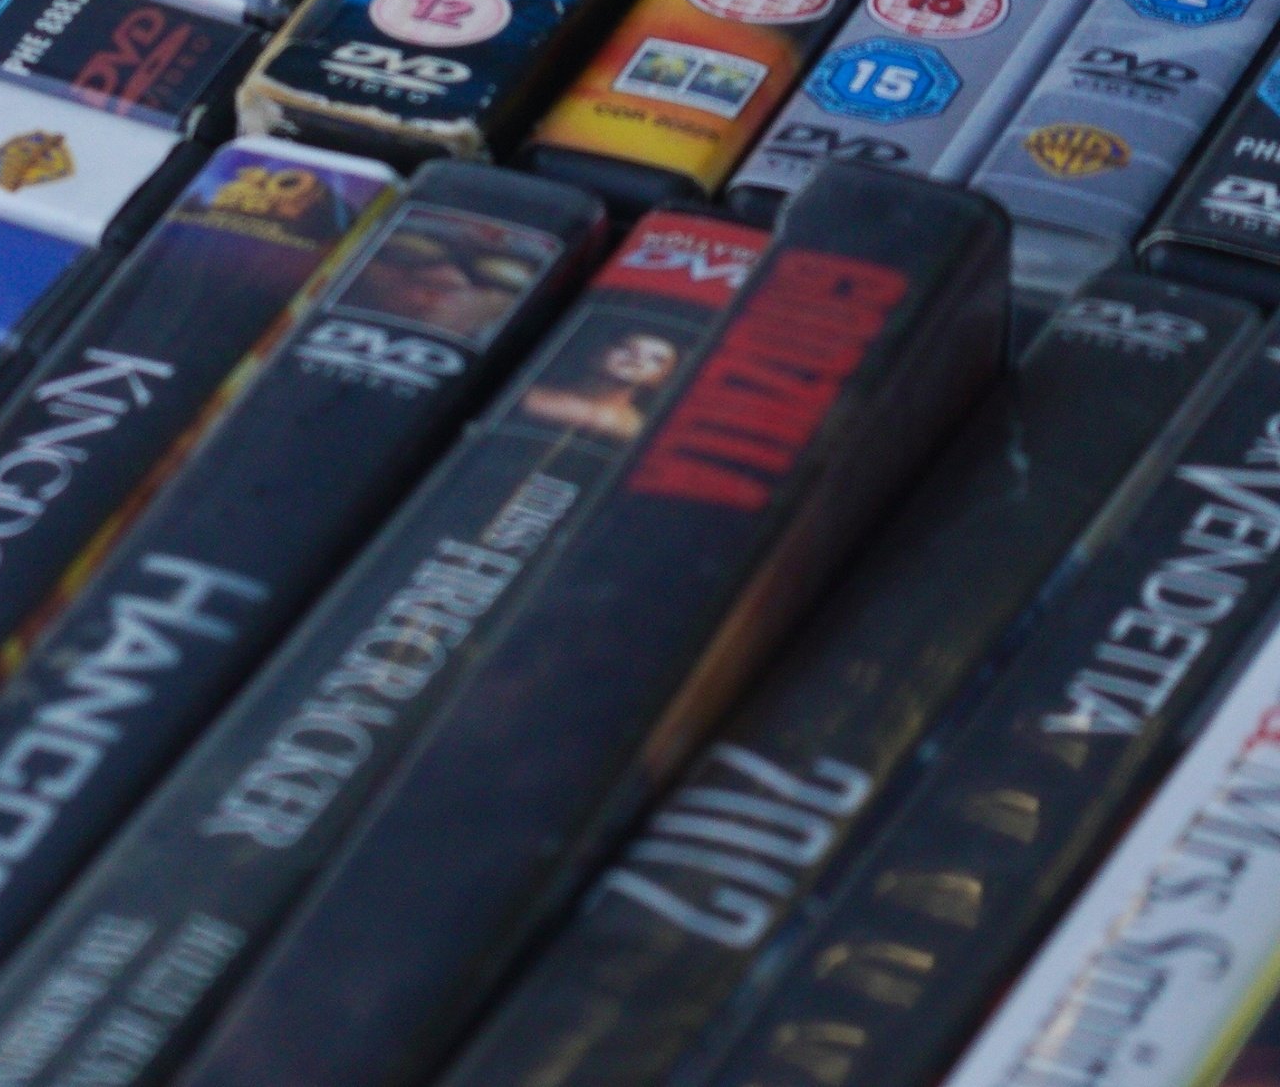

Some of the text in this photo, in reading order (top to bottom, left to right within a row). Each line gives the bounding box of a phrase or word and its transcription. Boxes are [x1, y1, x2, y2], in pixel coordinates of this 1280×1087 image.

[333, 41, 473, 84] DVD
[847, 60, 920, 103] 15
[1079, 46, 1200, 86] DVD
[303, 319, 469, 379] DVD
